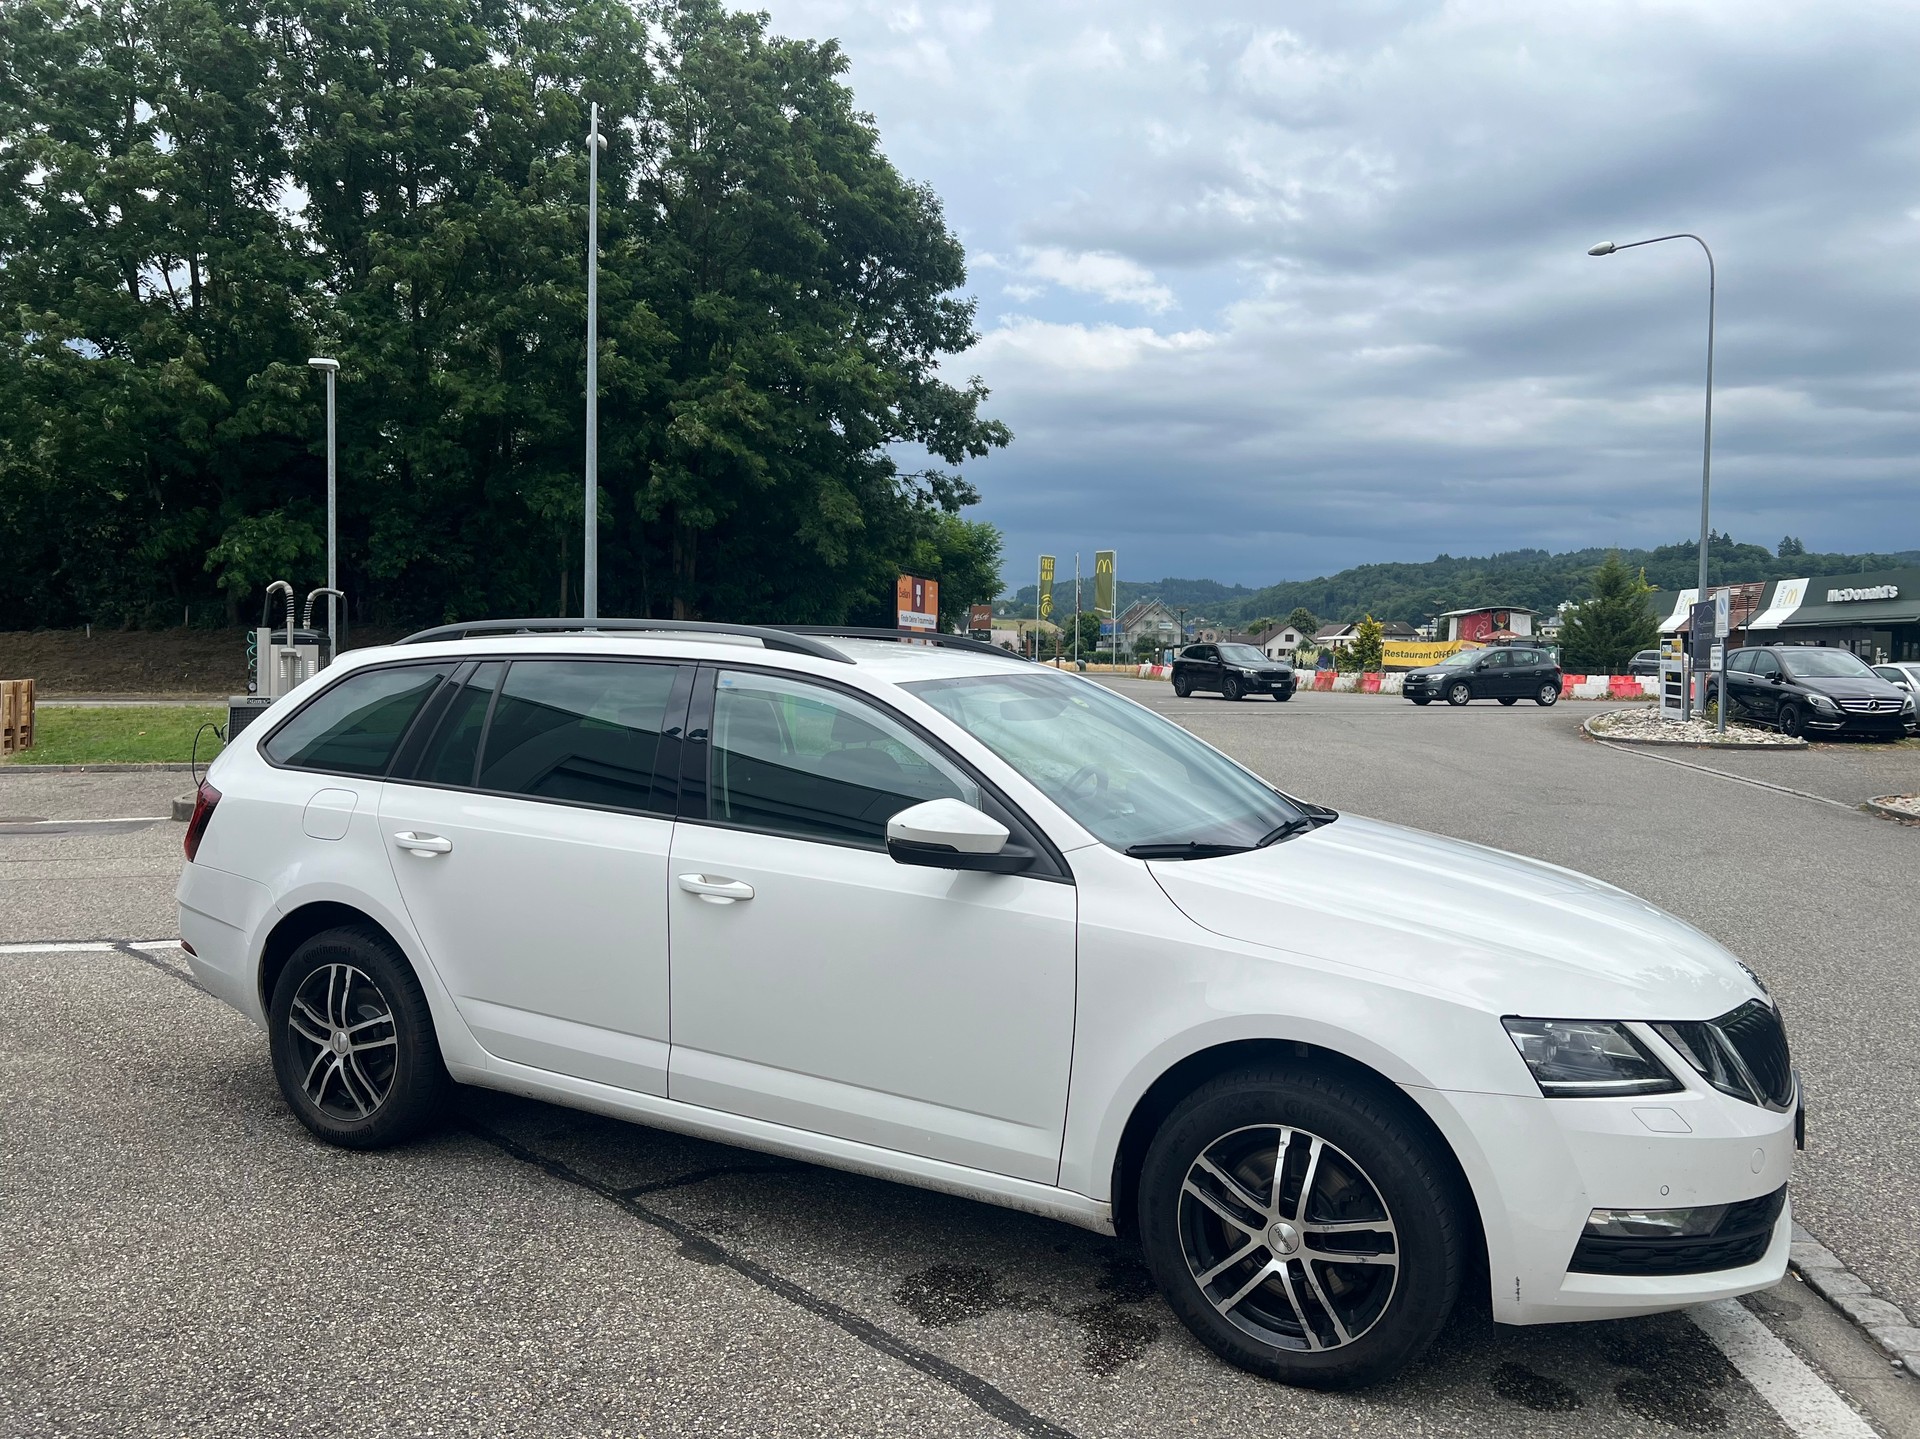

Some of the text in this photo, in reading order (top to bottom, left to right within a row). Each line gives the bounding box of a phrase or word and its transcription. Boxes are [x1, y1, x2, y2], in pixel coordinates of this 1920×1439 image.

[1042, 558, 1054, 570] FREE
[1827, 585, 1898, 602] McDonald's
[1384, 649, 1431, 659] Restaurant
[303, 944, 351, 962] Continental
